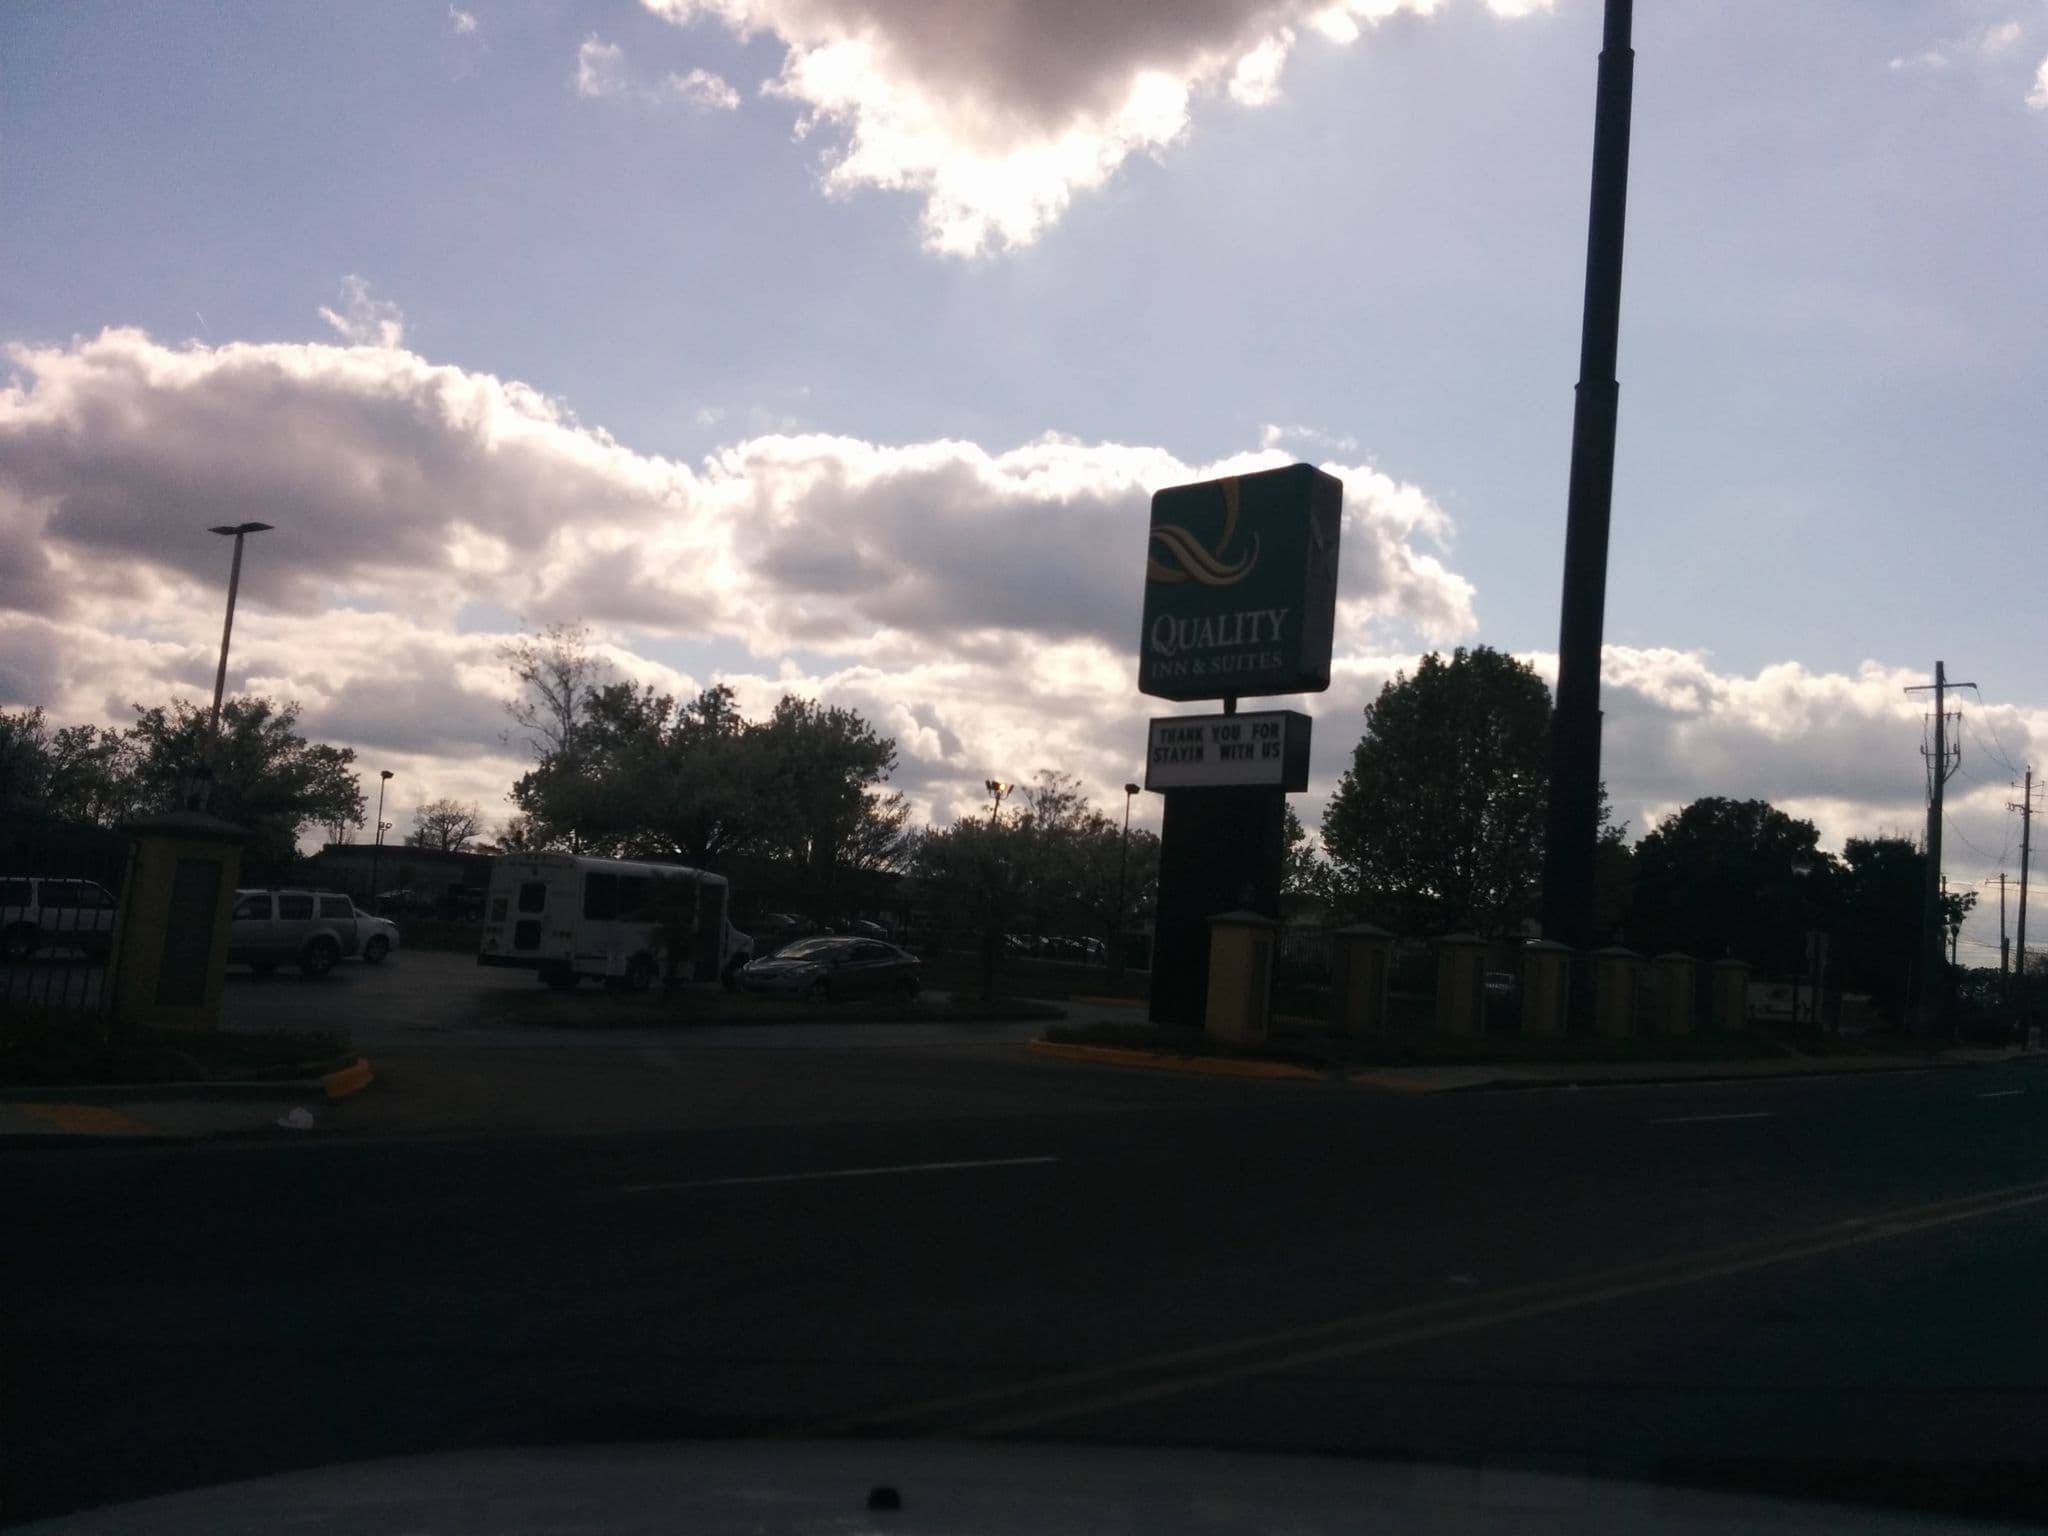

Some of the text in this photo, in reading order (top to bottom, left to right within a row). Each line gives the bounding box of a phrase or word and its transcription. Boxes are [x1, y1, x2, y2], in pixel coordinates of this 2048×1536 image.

[1151, 609, 1288, 656] QUALITY
[1153, 651, 1282, 679] INN & SUITES
[1160, 723, 1279, 745] THANK YOU FOR
[1153, 742, 1280, 763] STAYIN WITH US
